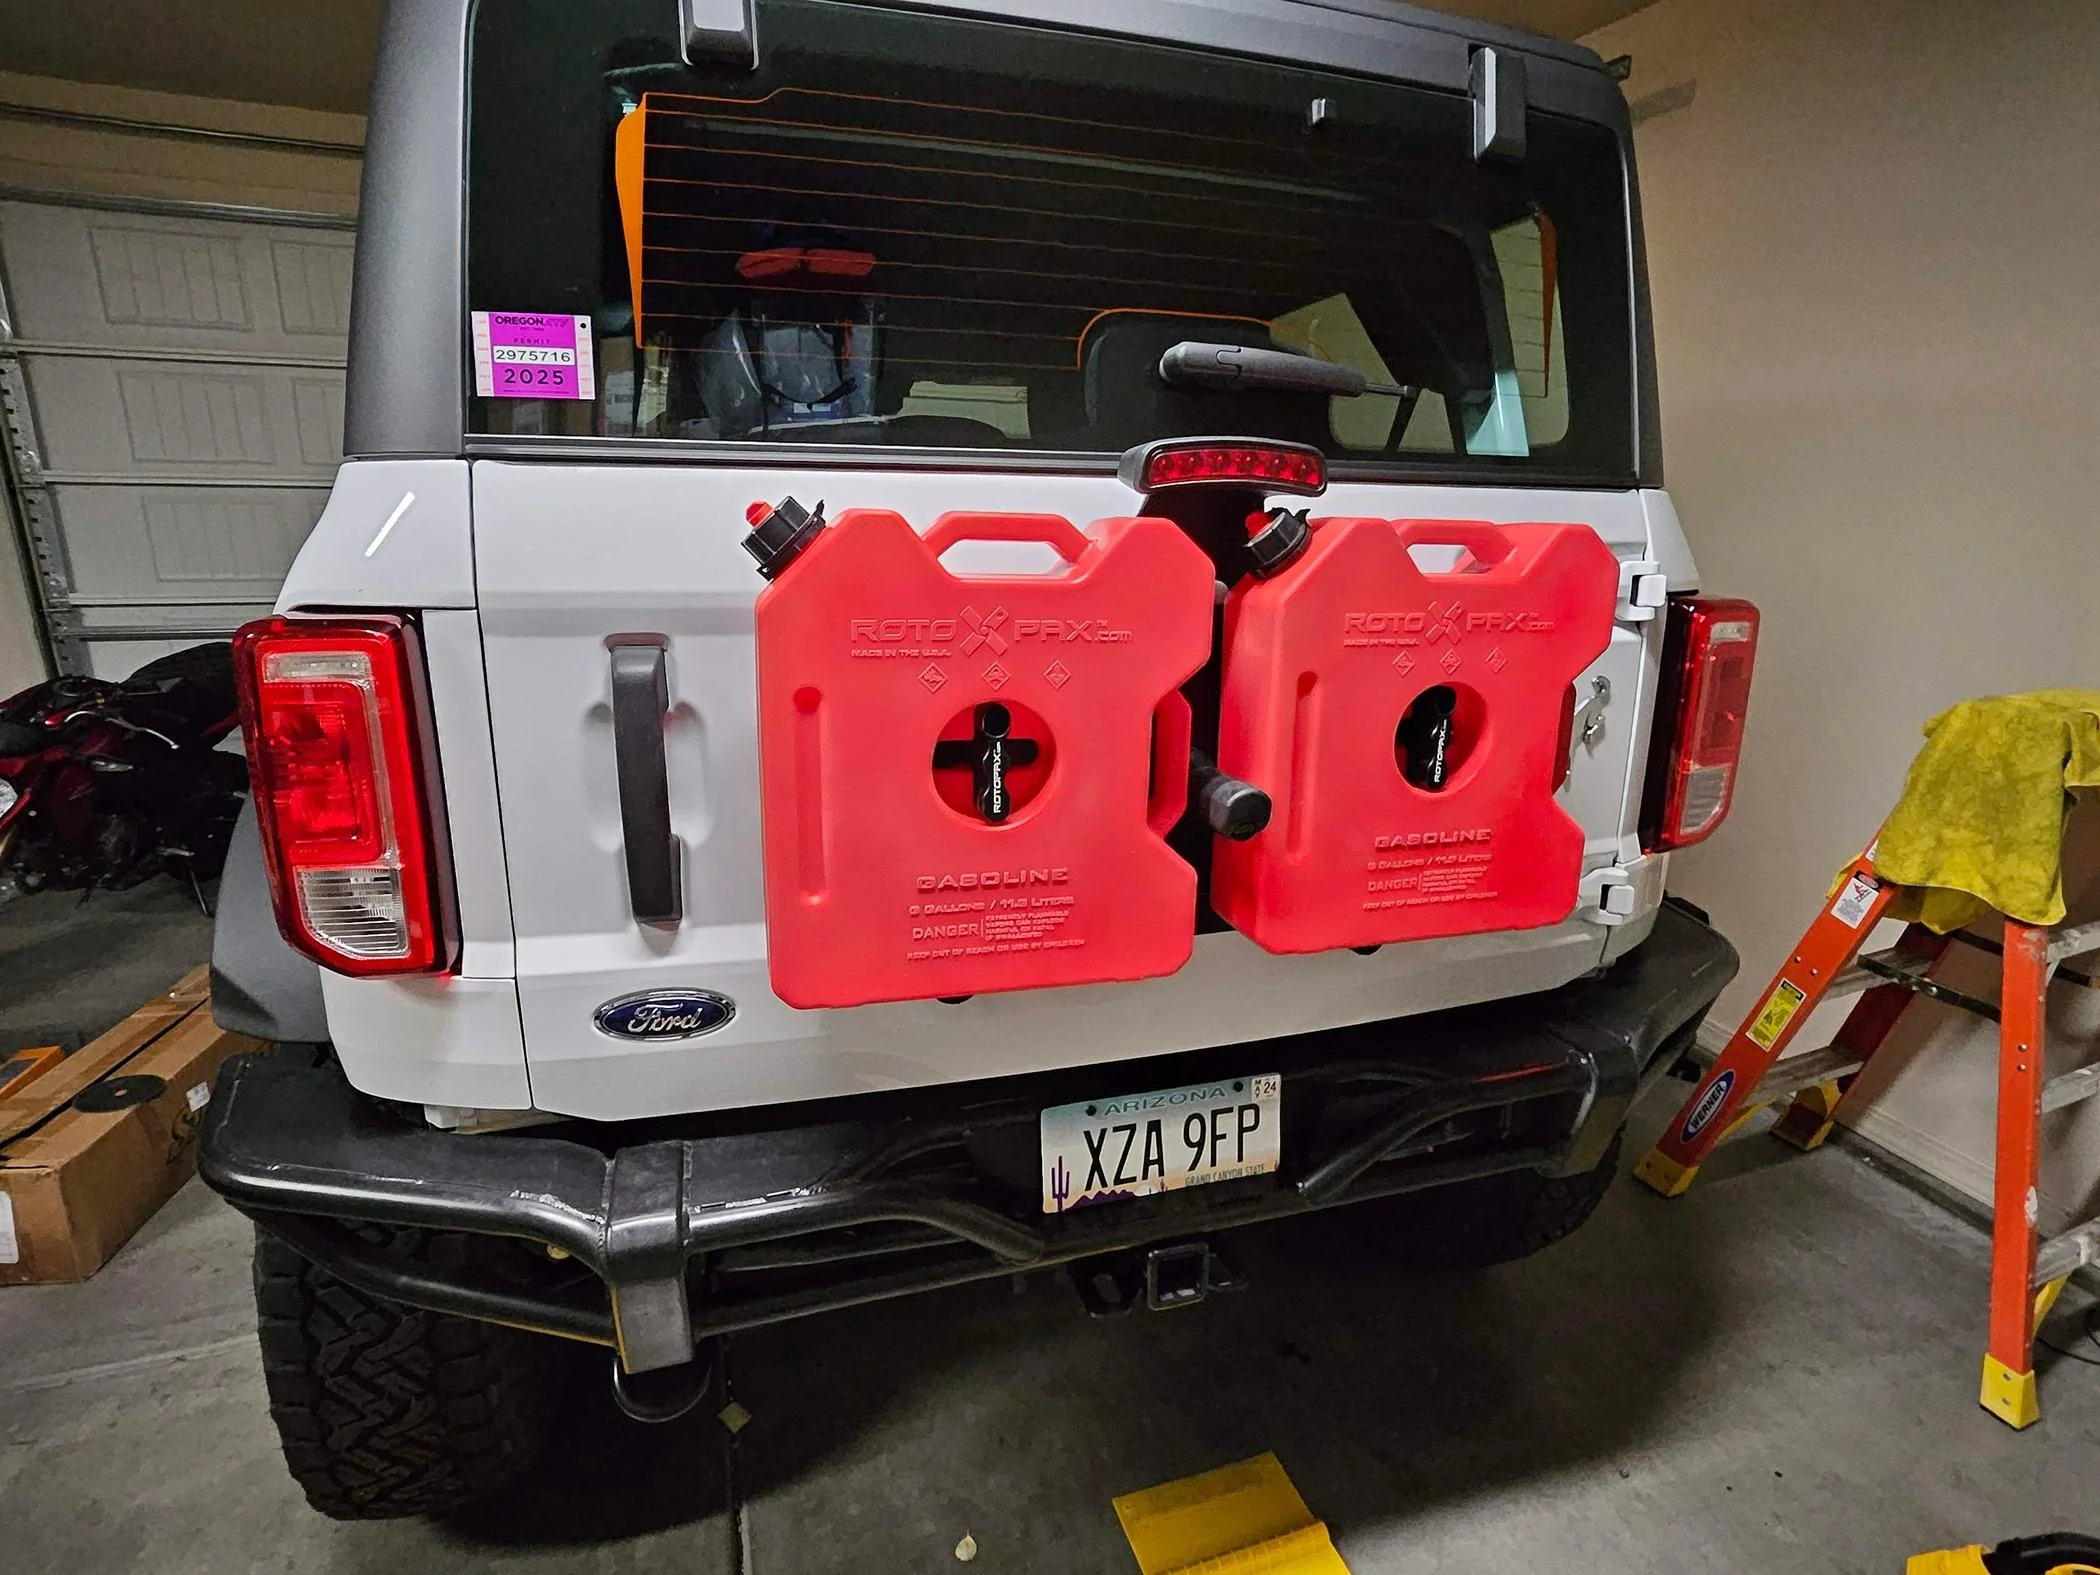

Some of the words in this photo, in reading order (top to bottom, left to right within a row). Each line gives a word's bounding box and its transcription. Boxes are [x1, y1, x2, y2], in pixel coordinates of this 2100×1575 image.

[495, 316, 544, 326] OREGON
[513, 337, 551, 345] PERMIT
[495, 349, 571, 362] 2975716
[504, 368, 565, 385] 2025
[850, 619, 957, 642] ROTO
[1343, 612, 1426, 633] ROTO
[899, 648, 920, 658] THE
[1374, 828, 1492, 849] GASOLINE
[915, 866, 1070, 892] GASOLINE
[1367, 876, 1418, 892] DANGER
[924, 902, 986, 914] GALLONS
[912, 922, 979, 939] DANGER
[627, 1002, 703, 1033] Ford
[1263, 1080, 1277, 1094] 24
[1104, 1086, 1227, 1116] ARIZONA
[1690, 1083, 1725, 1129] WERNER
[1083, 1119, 1166, 1192] XZA
[1183, 1102, 1261, 1172] 9FP
[1184, 1173, 1211, 1186] GRAND
[1213, 1168, 1243, 1181] CANYON
[1245, 1163, 1265, 1175] STATE
